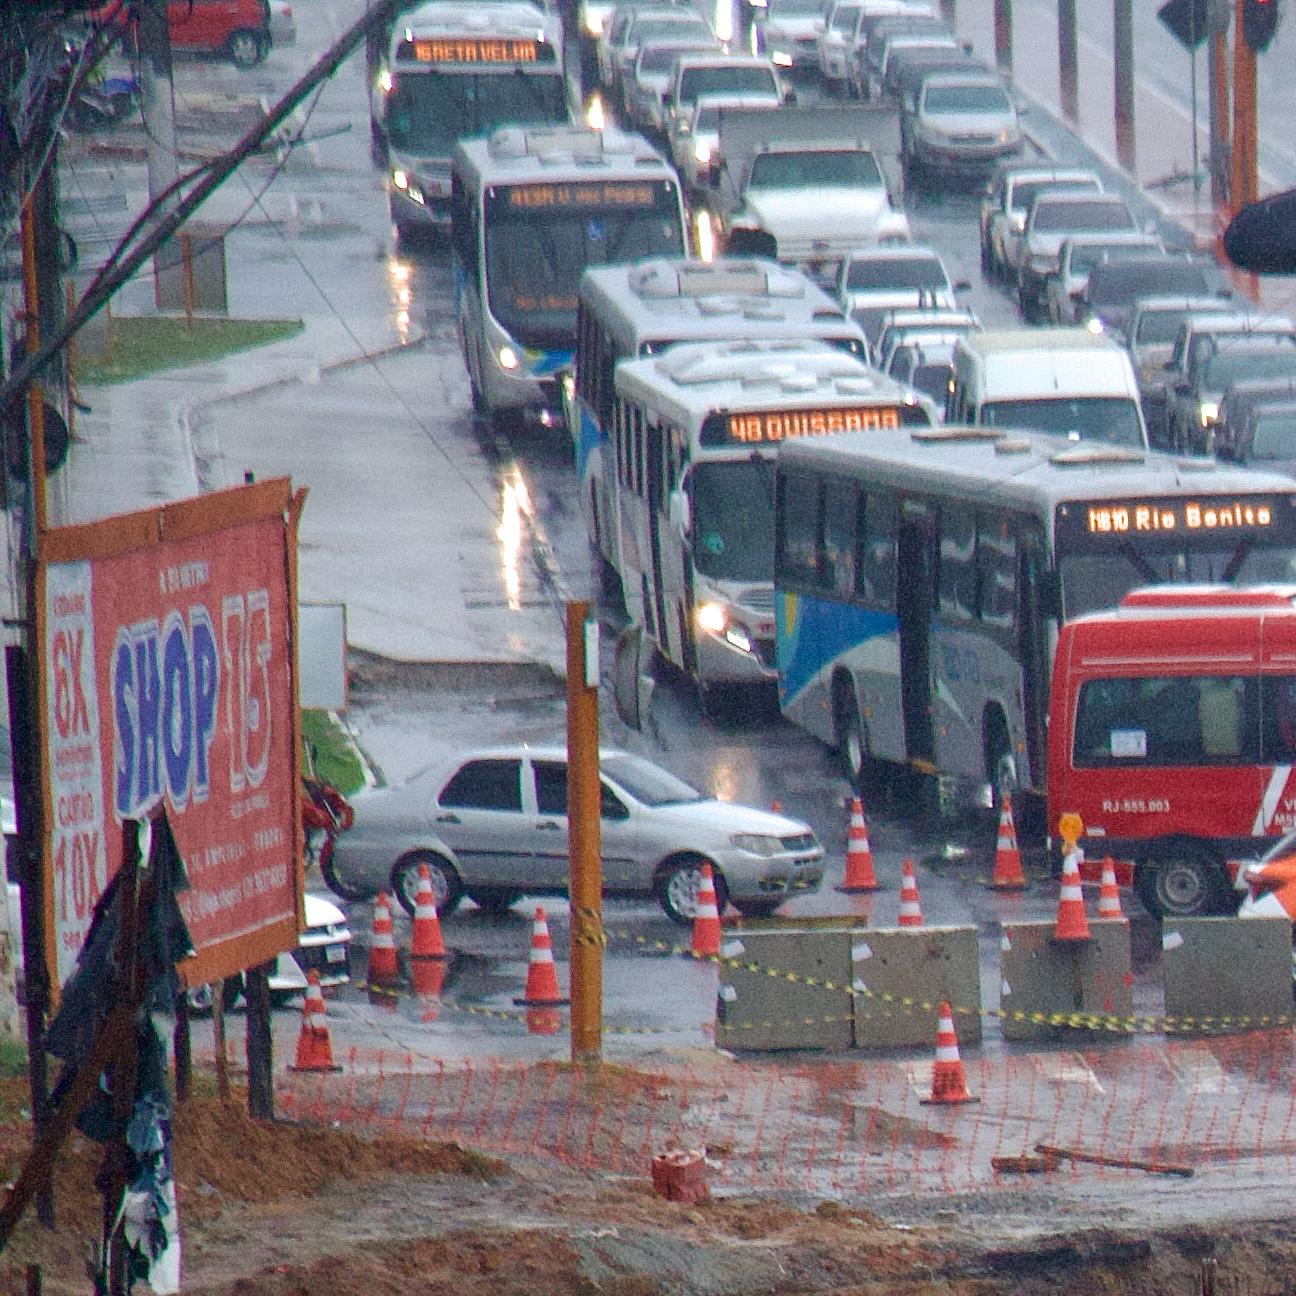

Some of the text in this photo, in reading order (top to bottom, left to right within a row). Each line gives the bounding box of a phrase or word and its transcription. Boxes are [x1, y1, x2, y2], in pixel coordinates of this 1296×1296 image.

[1136, 505, 1175, 529] Rio
[1186, 502, 1271, 527] Bonito
[112, 606, 219, 819] SHOP
